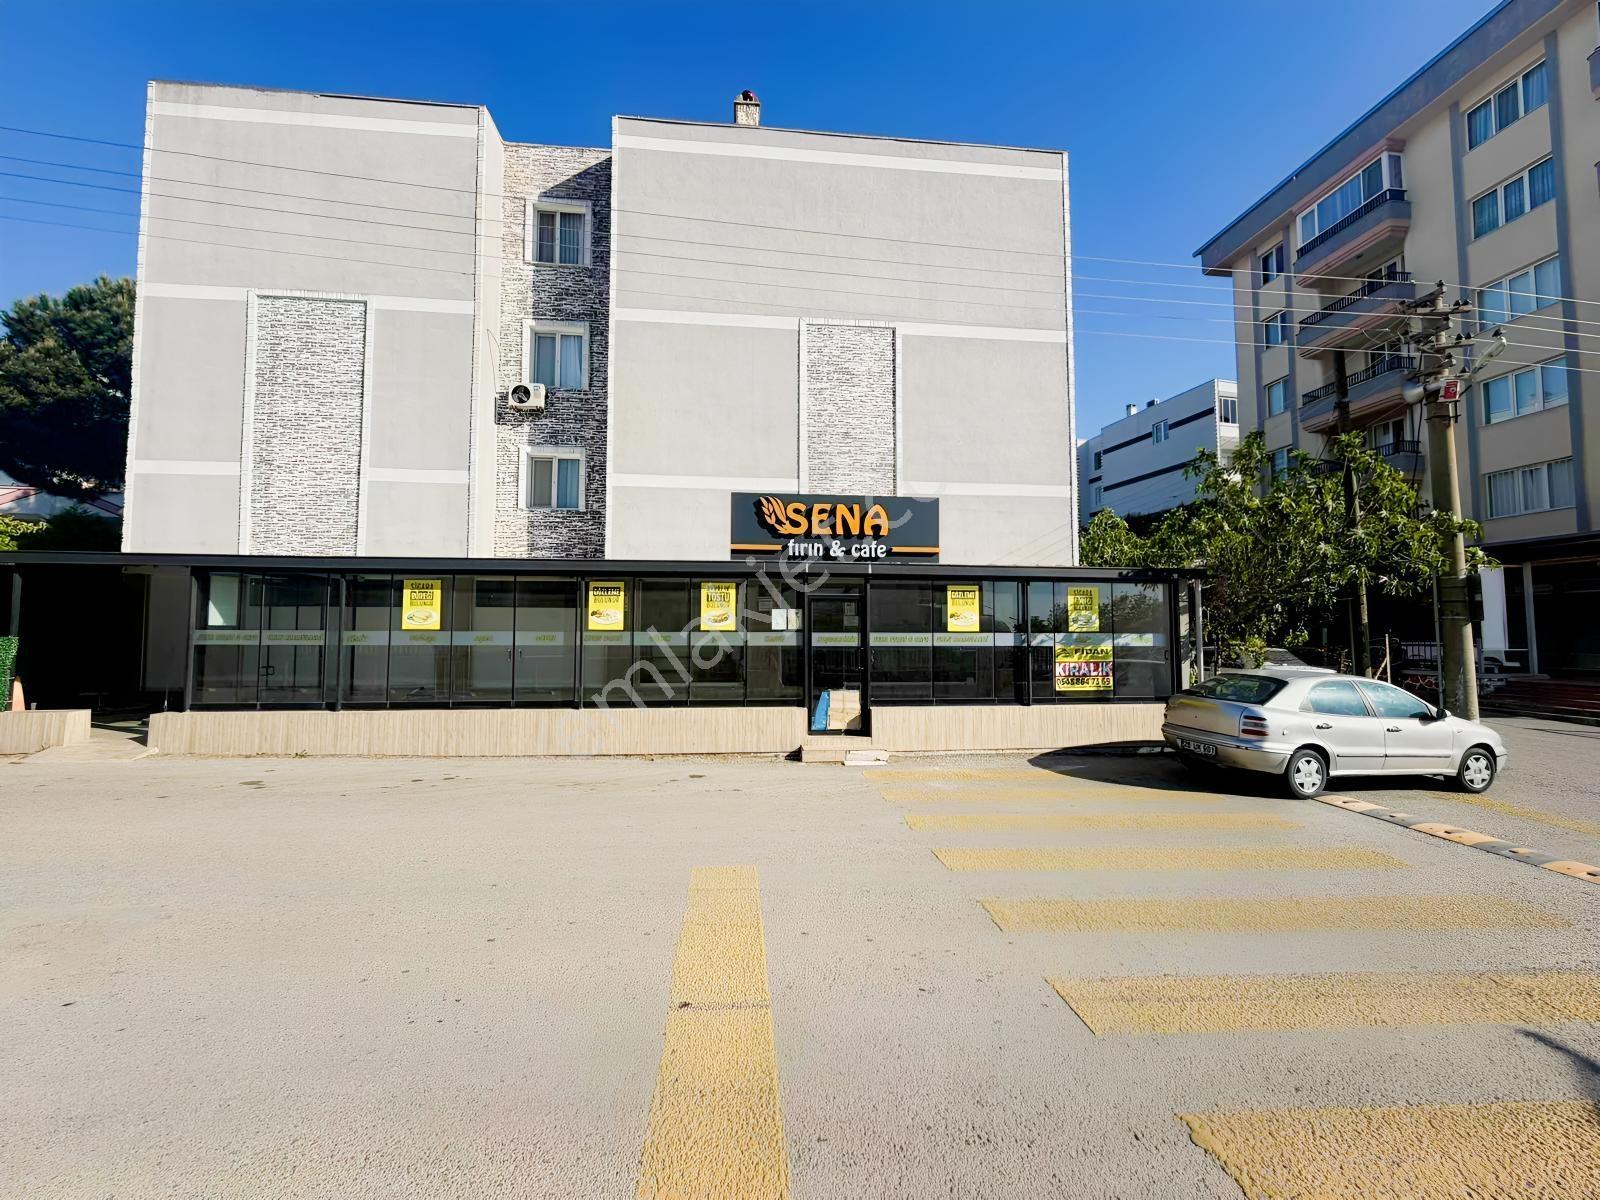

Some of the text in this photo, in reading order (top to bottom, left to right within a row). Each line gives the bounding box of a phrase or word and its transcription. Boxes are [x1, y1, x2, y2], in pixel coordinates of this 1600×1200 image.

[785, 503, 889, 536] SENA
[829, 539, 846, 558] &
[851, 540, 887, 558] cafe
